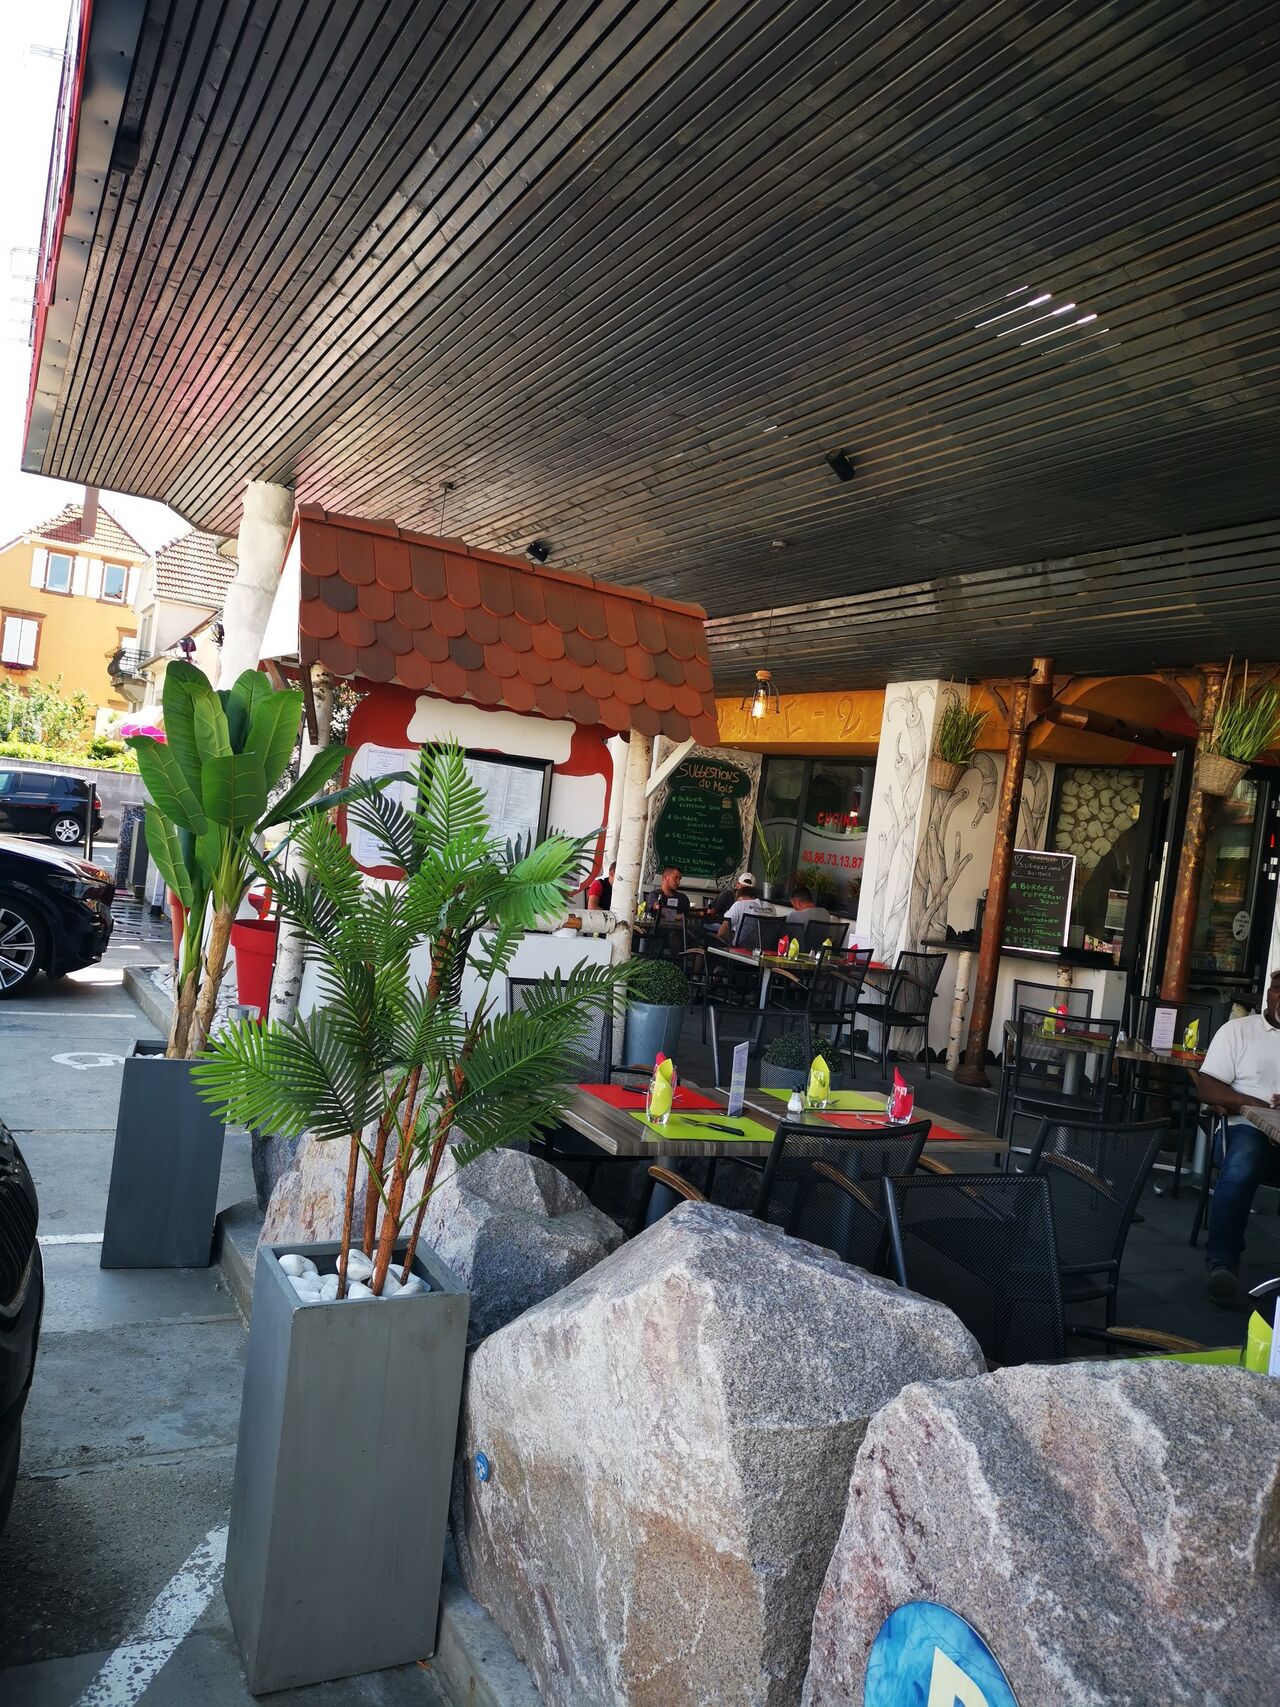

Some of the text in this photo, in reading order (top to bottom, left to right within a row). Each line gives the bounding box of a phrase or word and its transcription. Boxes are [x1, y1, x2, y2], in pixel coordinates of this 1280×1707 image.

[816, 811, 858, 827] CUCINA
[802, 849, 863, 869] 03.88.73.13.87
[1020, 882, 1055, 893] BURGER
[1013, 936, 1039, 945] PIZZA
